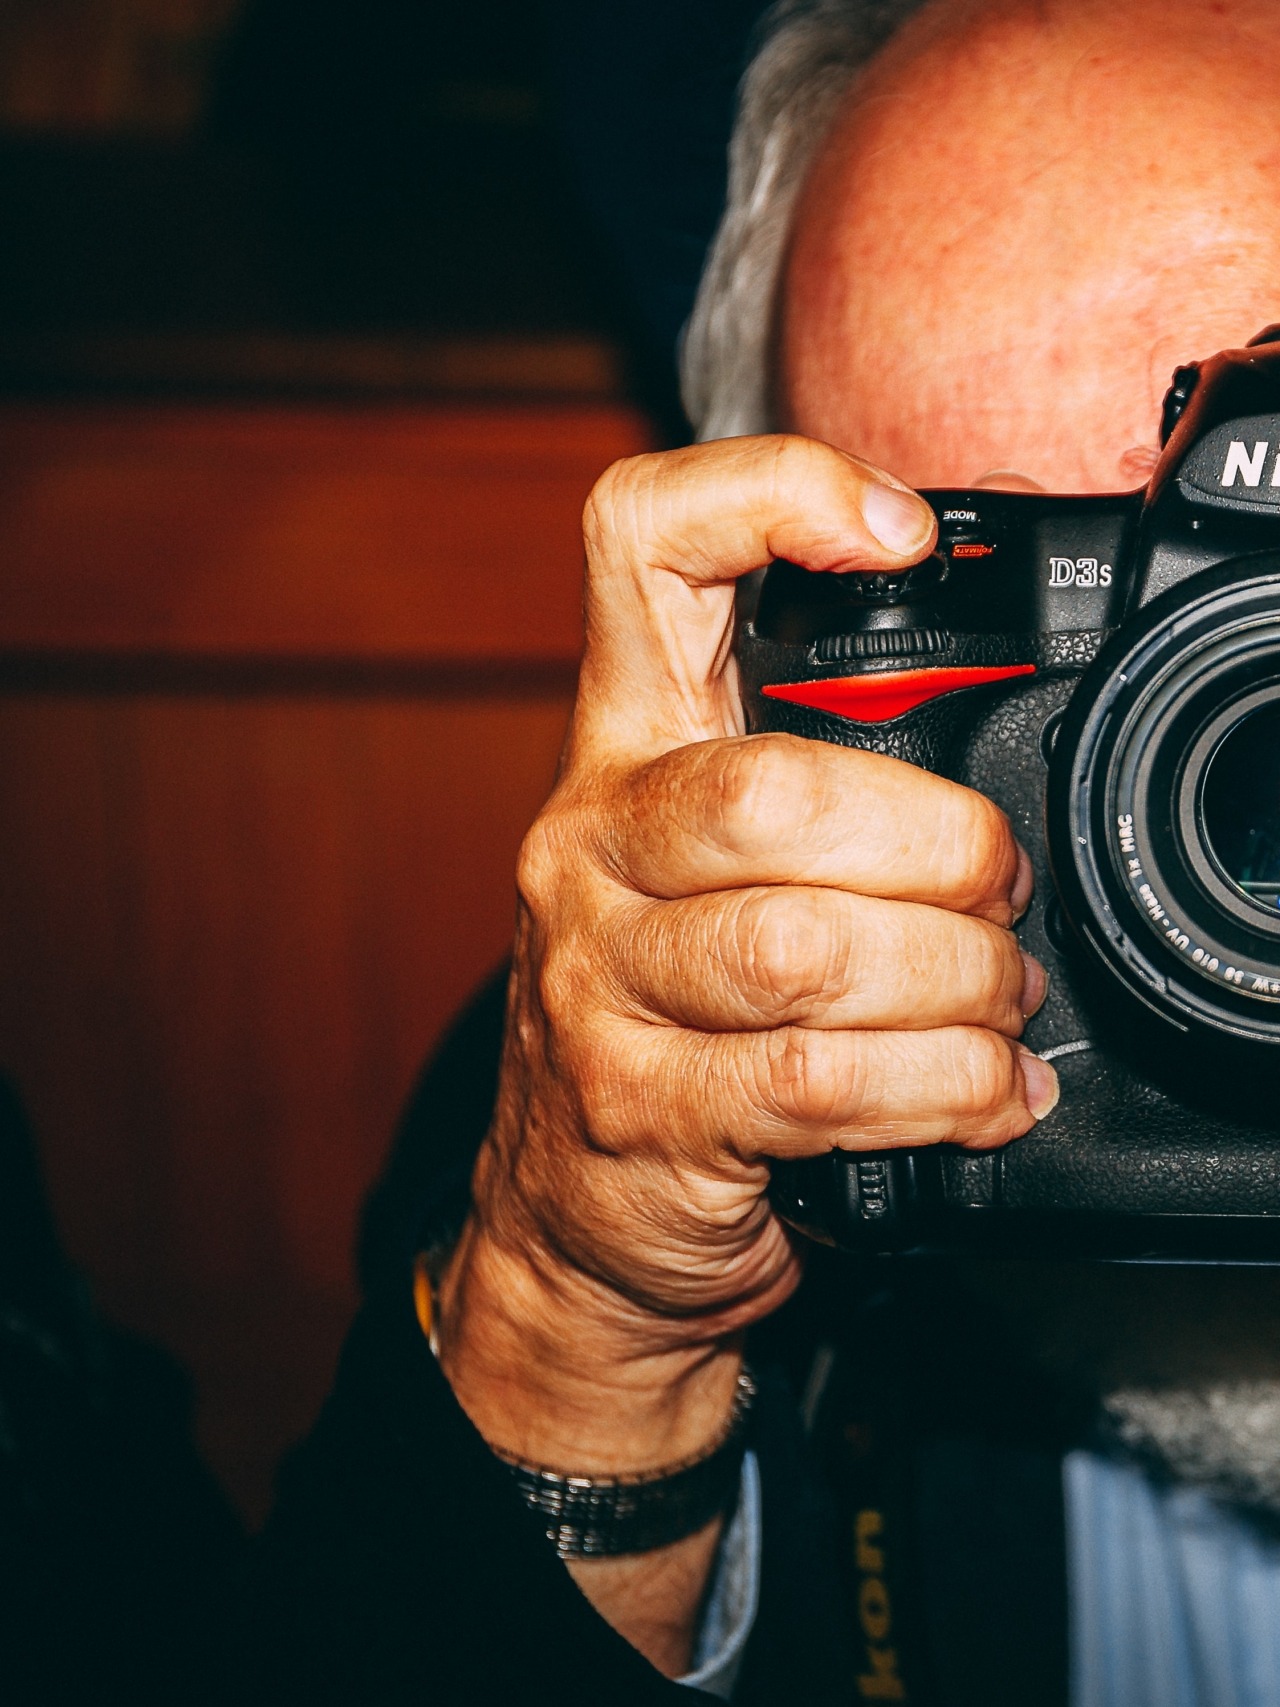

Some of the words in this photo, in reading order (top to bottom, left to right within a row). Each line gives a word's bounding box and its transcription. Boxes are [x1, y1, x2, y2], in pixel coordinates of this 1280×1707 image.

[943, 510, 976, 520] MODE
[1048, 556, 1113, 589] D3s
[1117, 813, 1136, 853] MRC
